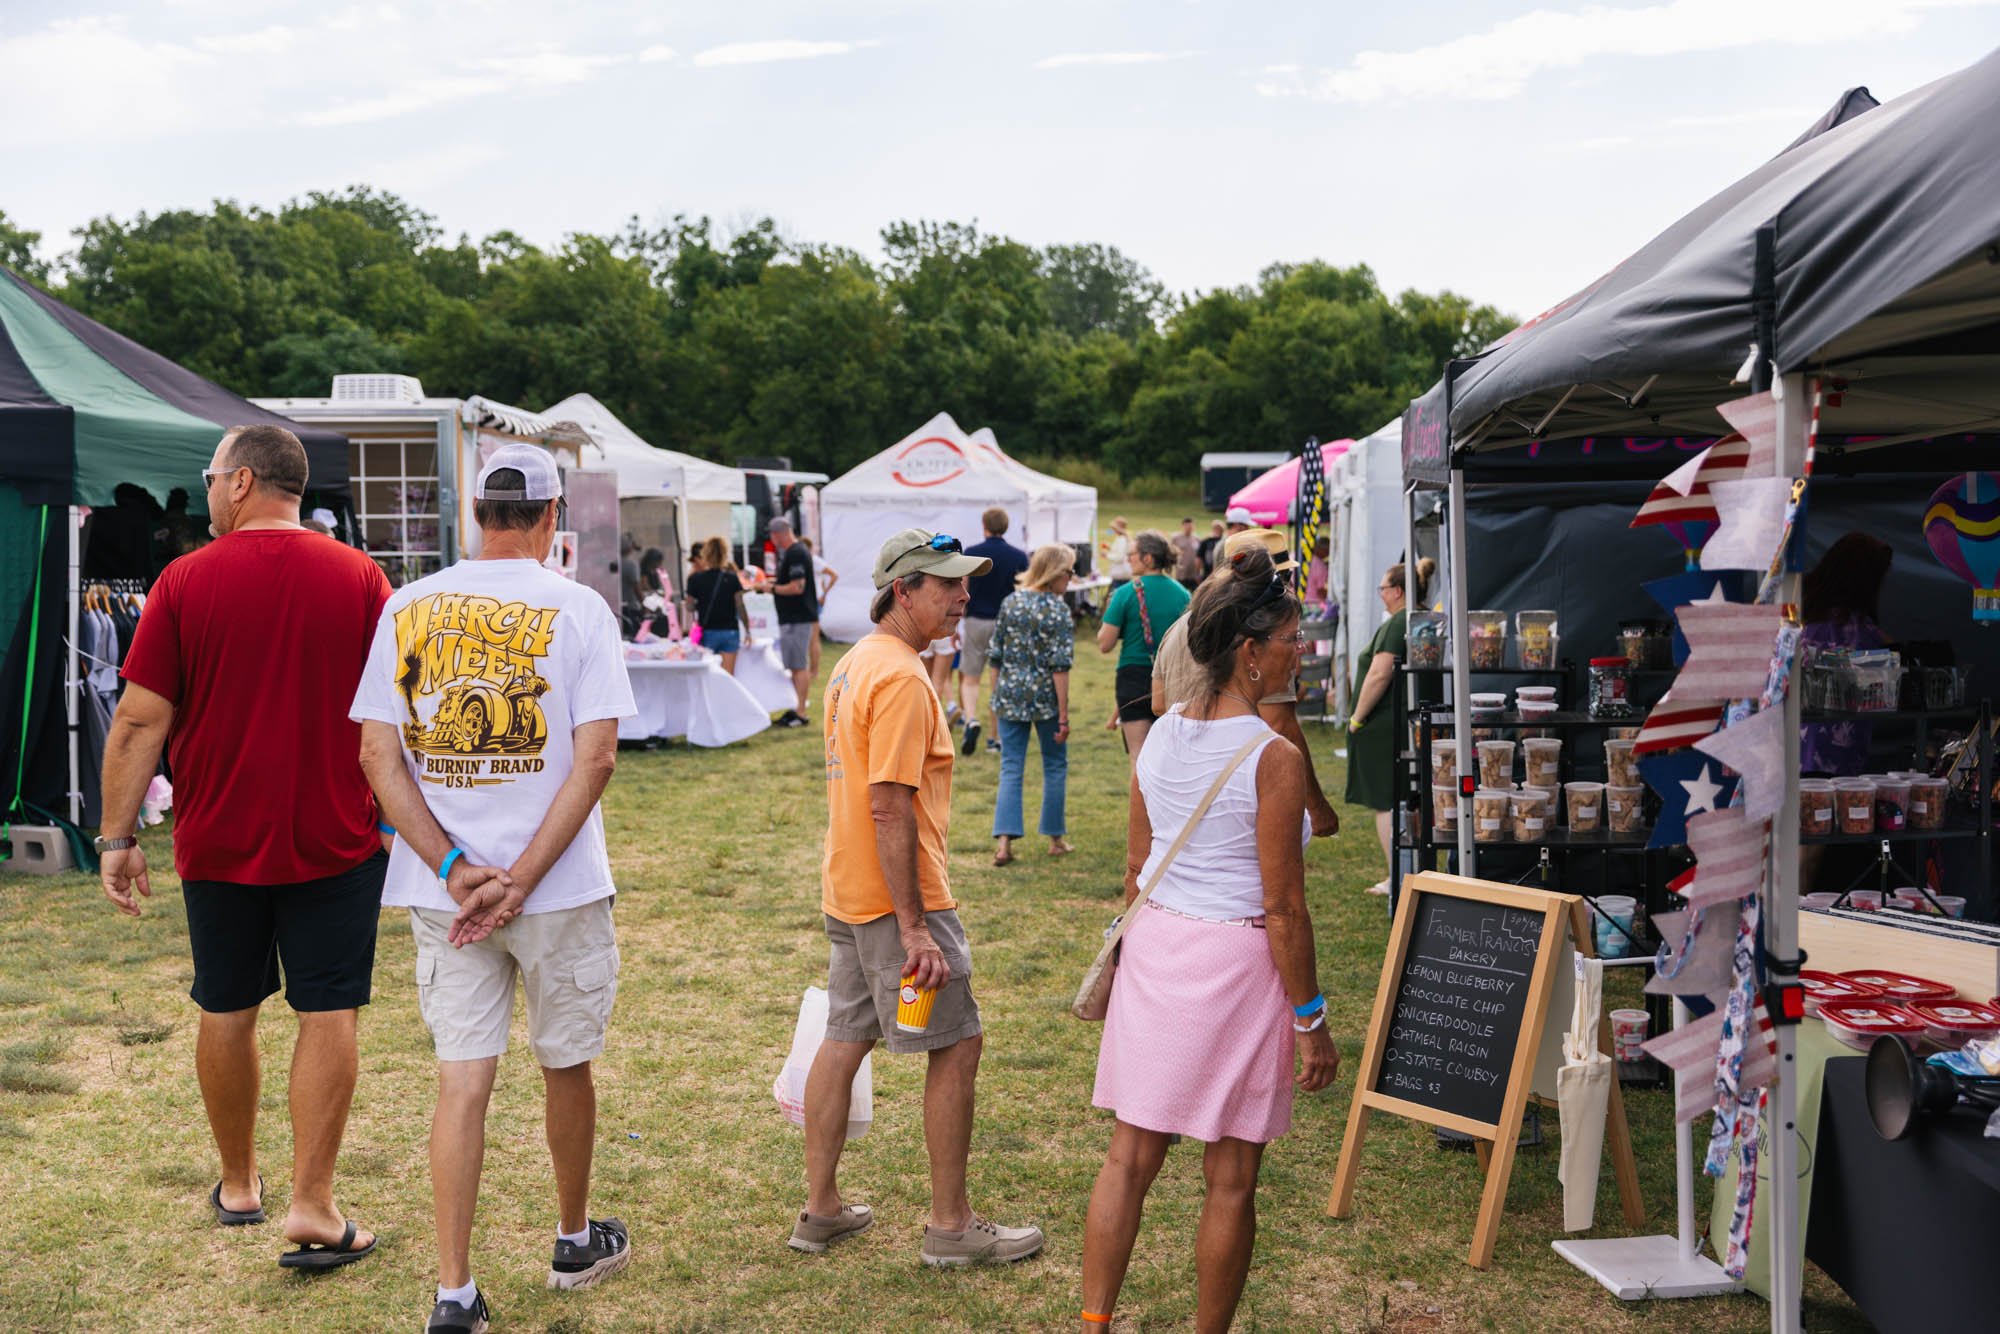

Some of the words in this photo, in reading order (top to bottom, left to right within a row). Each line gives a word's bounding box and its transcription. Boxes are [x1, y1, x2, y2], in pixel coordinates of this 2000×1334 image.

[394, 592, 560, 683] MARCH
[420, 632, 536, 696] MEET
[427, 758, 486, 775] BURNIN'
[490, 758, 545, 774] BRAND
[446, 775, 474, 788] USA
[1406, 963, 1443, 983] LEMON
[1446, 971, 1515, 995] BLUEBERRY
[1402, 984, 1468, 1009] CHOCOLATE
[1473, 1000, 1505, 1015] CHIP
[1397, 1003, 1495, 1037] SNICKERDOODLE
[1391, 1026, 1443, 1050] OATMEAL
[1448, 1038, 1489, 1059] RAISIN
[1386, 1048, 1443, 1071] O-STATE
[1446, 1062, 1499, 1086] COWBOY
[1394, 1074, 1423, 1090] BAGS
[1428, 1083, 1441, 1094] $3
